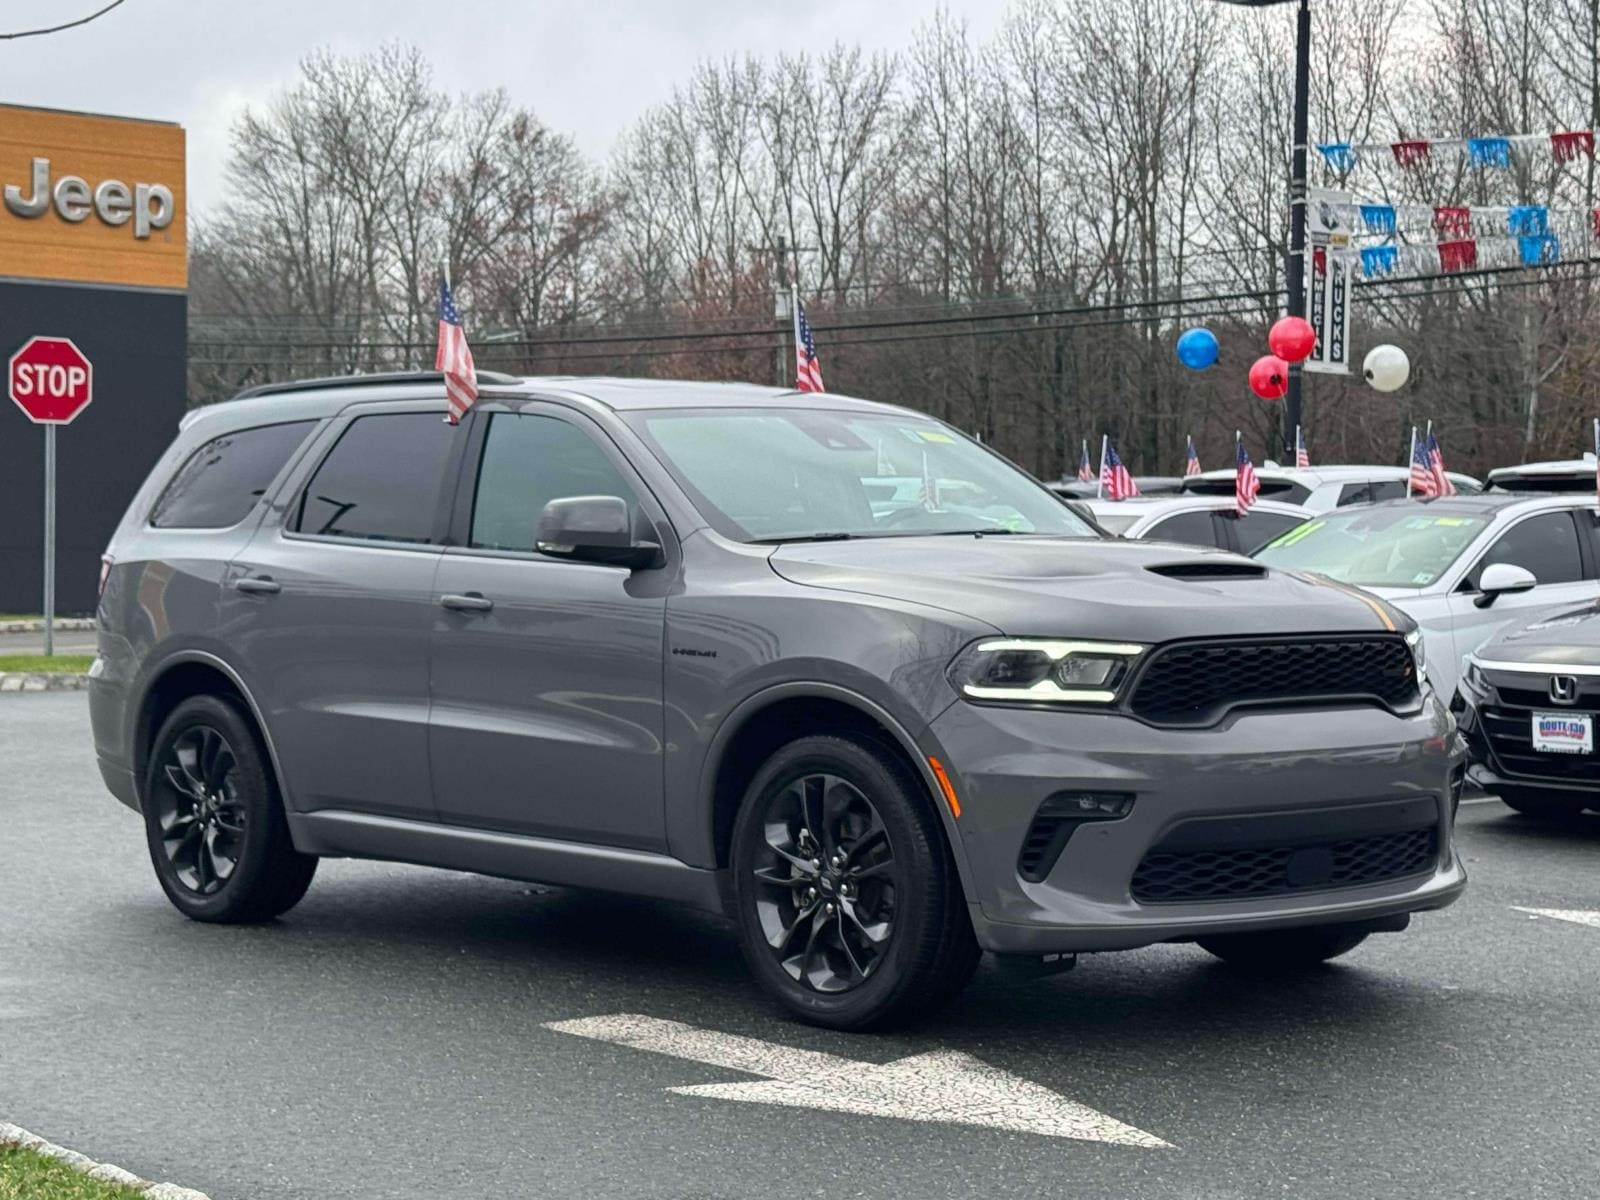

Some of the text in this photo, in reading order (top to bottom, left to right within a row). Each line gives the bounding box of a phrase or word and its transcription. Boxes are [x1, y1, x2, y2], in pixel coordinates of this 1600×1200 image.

[4, 157, 174, 238] Jeep
[1333, 263, 1343, 359] RUCKS
[15, 363, 86, 398] STOP
[1539, 721, 1567, 732] ROUTE
